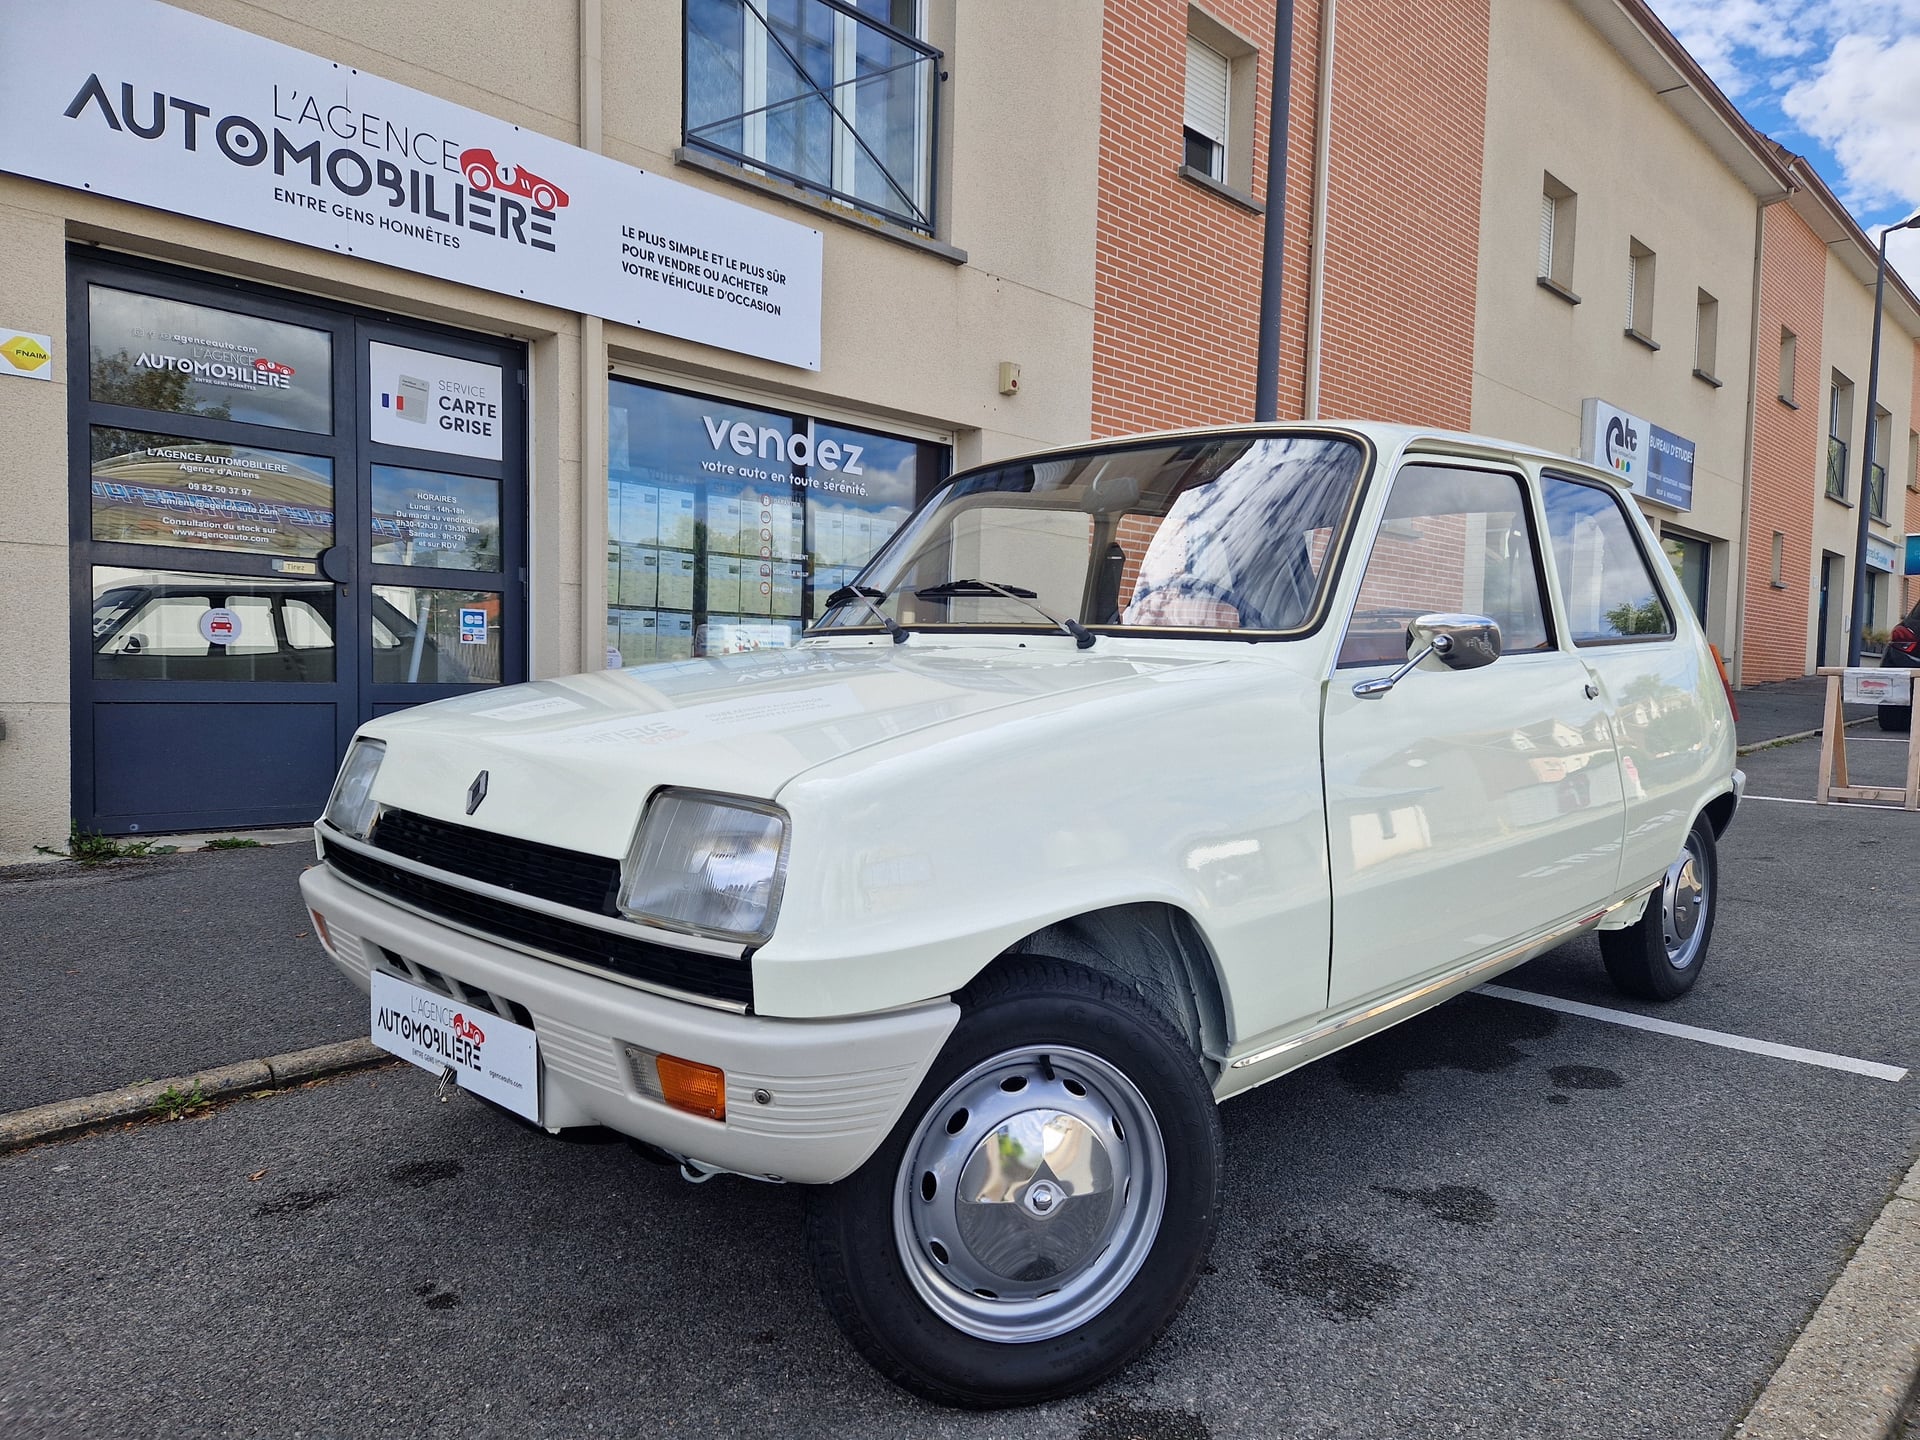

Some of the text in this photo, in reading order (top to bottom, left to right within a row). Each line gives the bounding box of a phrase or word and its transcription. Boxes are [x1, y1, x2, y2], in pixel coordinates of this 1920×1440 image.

[273, 84, 460, 174] L'AGENCE
[63, 72, 556, 253] AUTOMOBILIERE
[274, 188, 460, 249] ENTRE GENS HONNÊTES
[622, 225, 786, 285] LE PLUS SIMPLE ET LE PLUS SÛR
[622, 243, 768, 296] POUR VENDRE OU ACHETER
[622, 260, 781, 316] VOTRE VÉHICULE D'OCCASION
[15, 349, 47, 360] FNAIM
[174, 333, 258, 354] agenceauto.com
[193, 346, 255, 367] L'AGENCE
[135, 352, 291, 389] AUTOMOBILIERE
[438, 379, 486, 398] SERVICE
[439, 396, 497, 419] CARTE
[439, 415, 492, 437] GRISE
[702, 415, 864, 476] vendez
[1649, 435, 1670, 455] BUREAU
[1670, 444, 1694, 464] D'ETUDES
[147, 448, 289, 473] L'AGENCE AUTOMOBILIERE
[179, 463, 260, 480] Agence d'Amiens
[188, 482, 252, 496] 09 82 50 37 97
[702, 460, 735, 475] votre
[738, 466, 767, 480] auto
[771, 473, 785, 483] en
[789, 473, 819, 488] toute
[823, 477, 869, 497] sérénité.
[160, 498, 279, 516] amiens@agenceauto.com
[409, 503, 431, 511] Lundi
[417, 493, 457, 504] HORAIRES
[162, 516, 221, 529] Consultation
[223, 521, 235, 530] du
[237, 523, 260, 533] stock
[408, 512, 430, 520] mardi
[172, 528, 269, 544] www.agenceauto.com
[408, 529, 437, 538] Samedi
[286, 563, 305, 571] Tirez
[410, 995, 454, 1028] L'AGENCE
[377, 1006, 482, 1072] AUTOMOBILIERE
